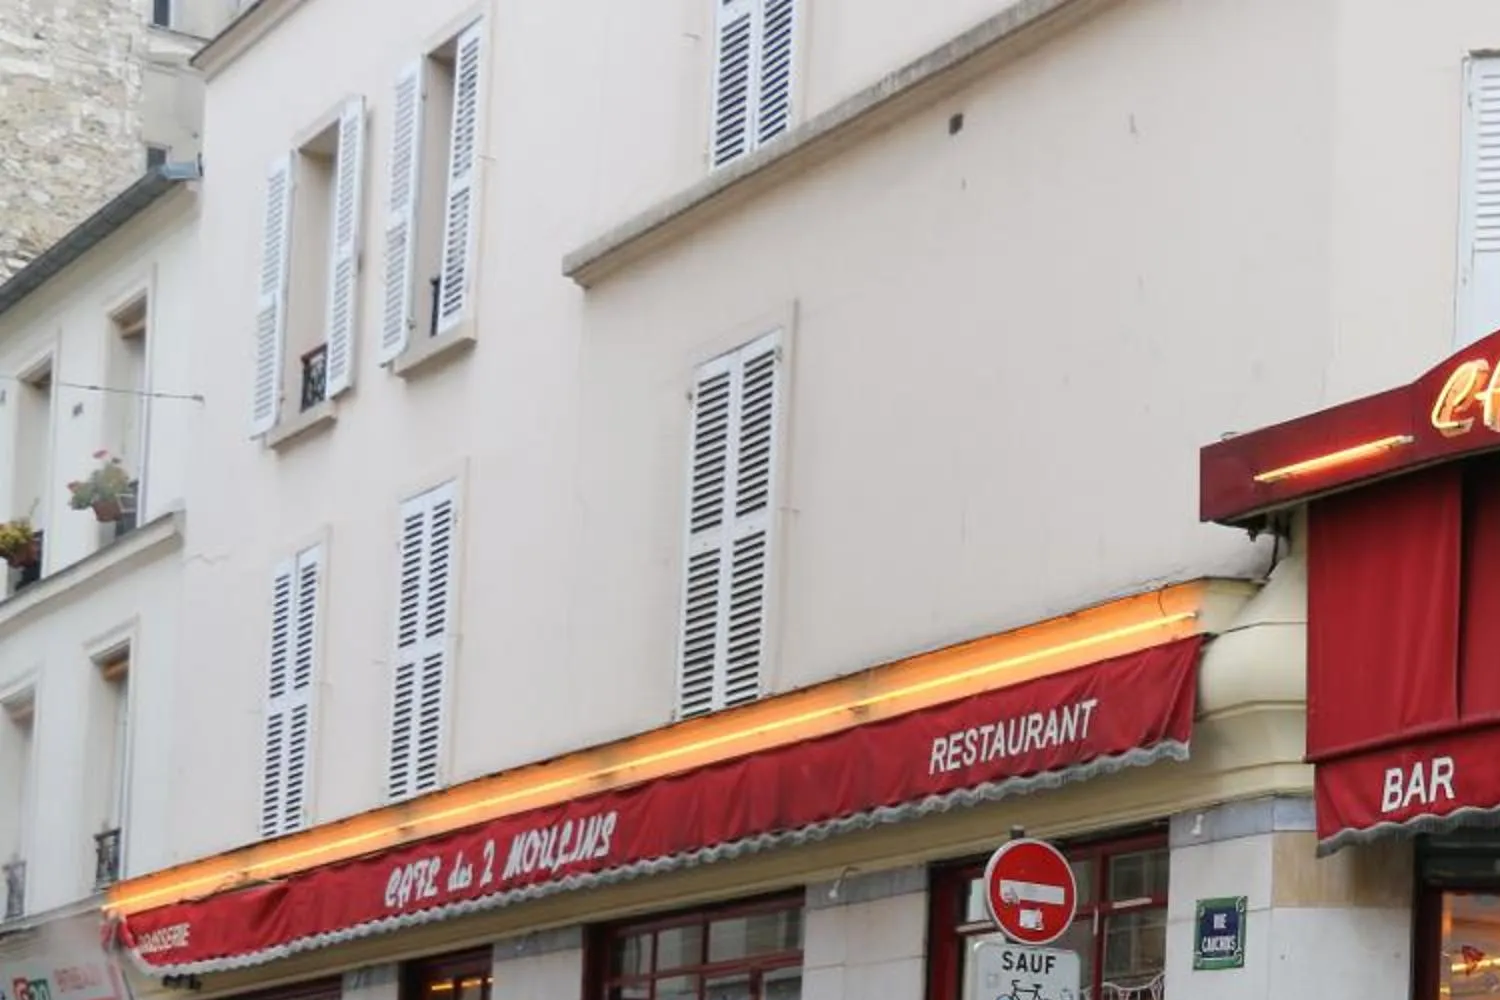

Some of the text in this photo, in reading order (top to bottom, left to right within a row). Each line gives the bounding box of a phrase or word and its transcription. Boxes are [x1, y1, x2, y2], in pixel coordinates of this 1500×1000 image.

[928, 699, 1099, 776] RESTAURANT
[1382, 756, 1456, 813] BAR
[385, 811, 617, 908] CAFE des 2 MOULINS
[1001, 951, 1056, 975] SAUF
